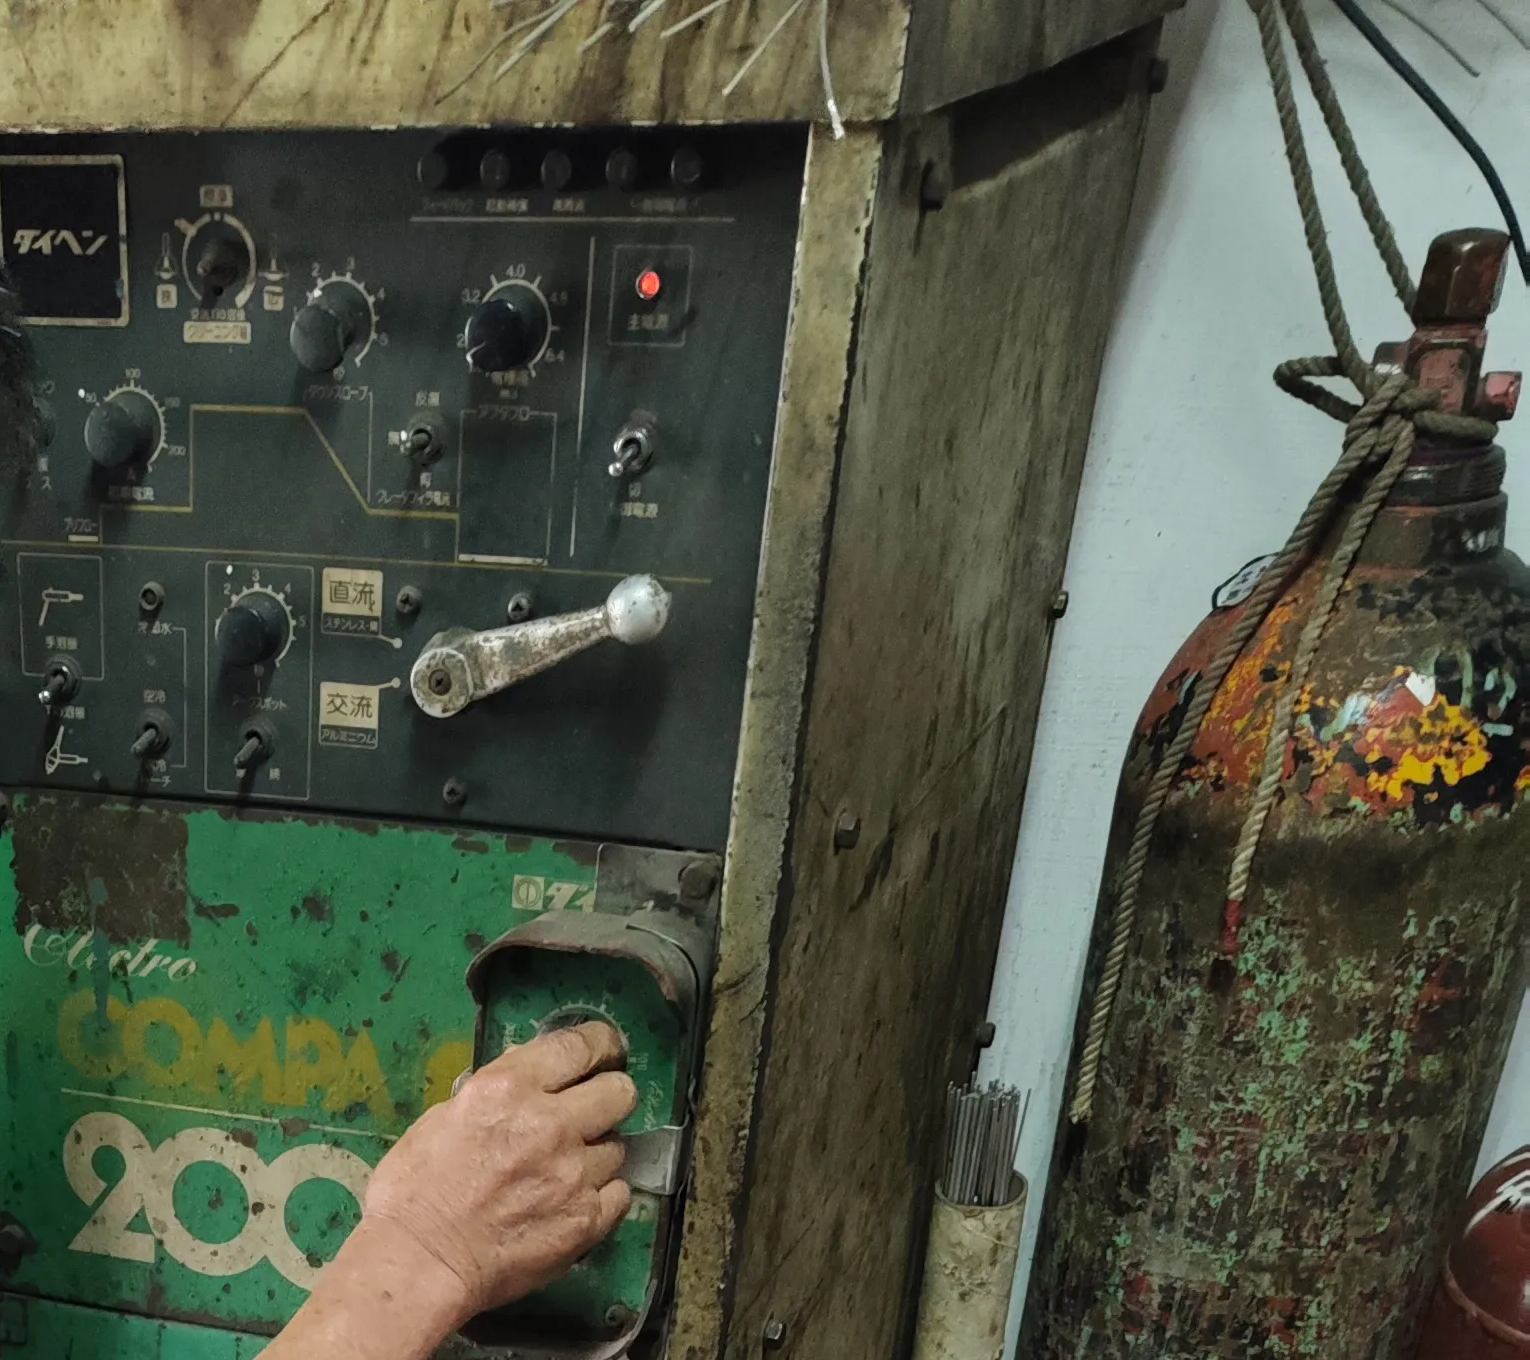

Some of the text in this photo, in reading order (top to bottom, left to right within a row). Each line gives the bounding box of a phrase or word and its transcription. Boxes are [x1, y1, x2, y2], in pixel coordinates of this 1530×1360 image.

[12, 228, 108, 256] タイヘン
[328, 579, 376, 613] 直流
[326, 692, 374, 719] 交流
[62, 1110, 378, 1292] 200
